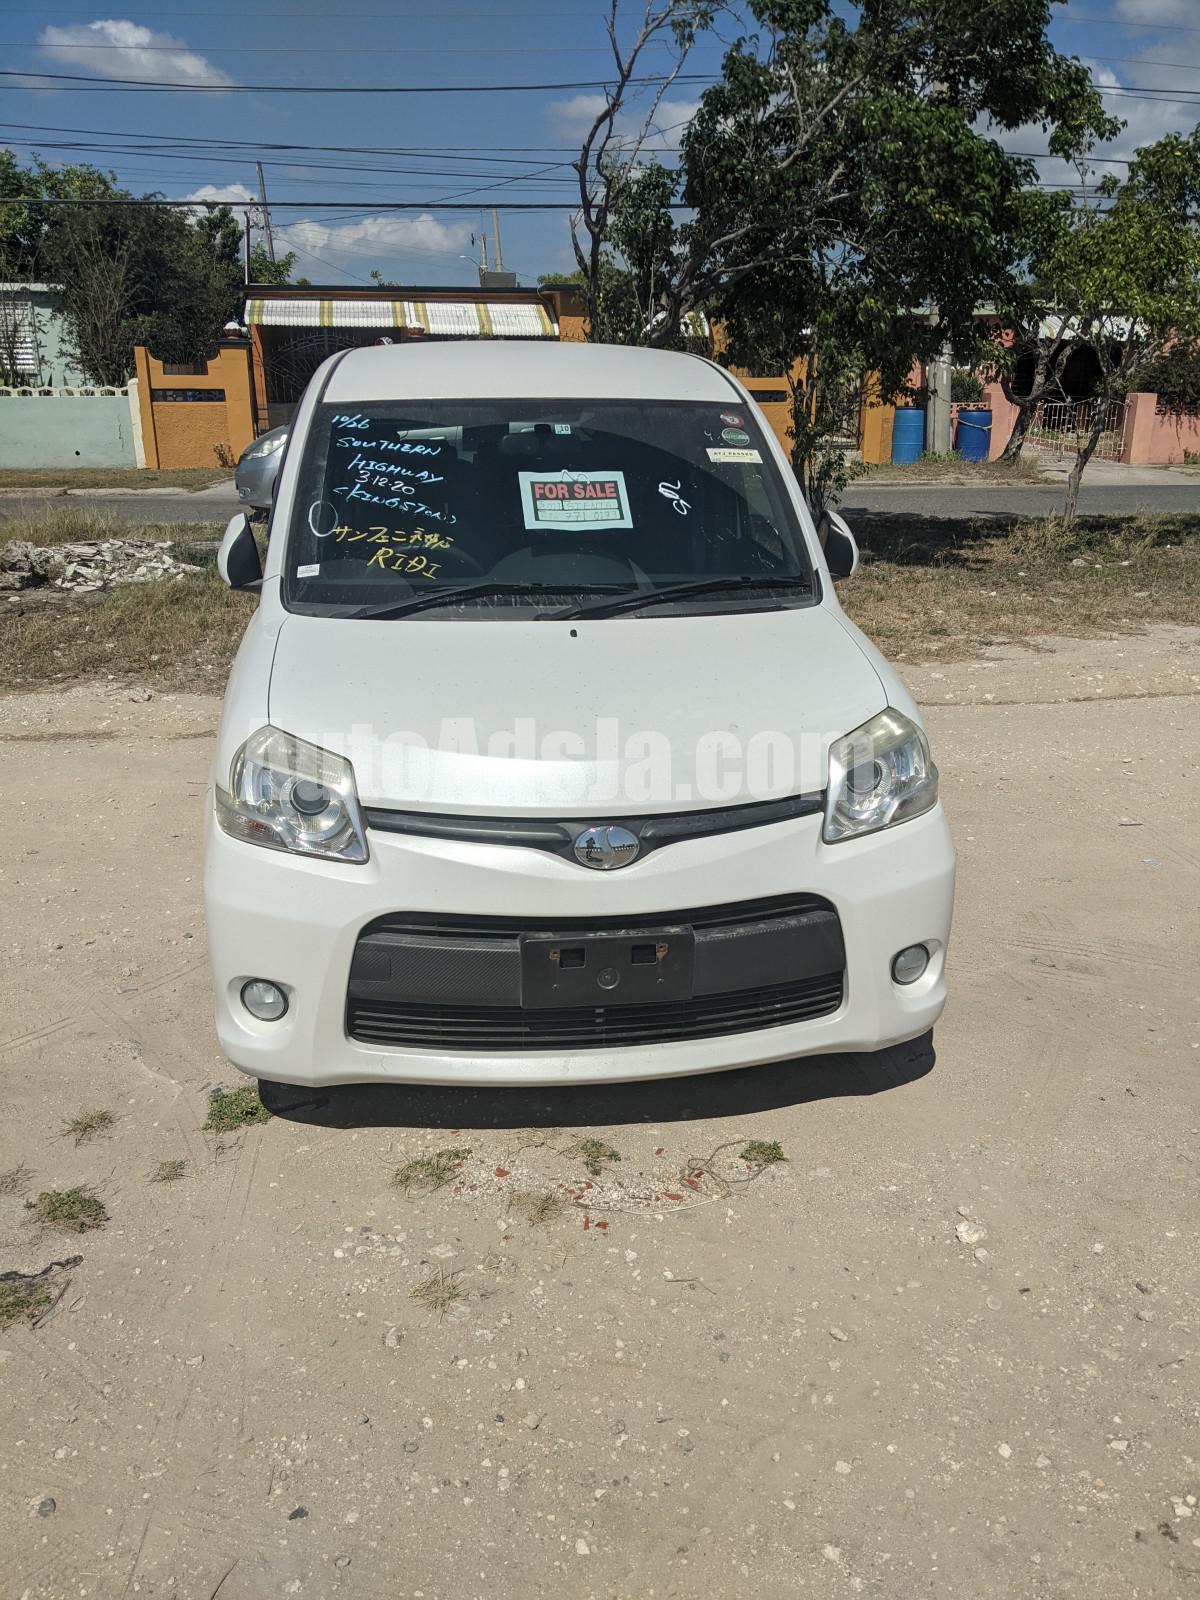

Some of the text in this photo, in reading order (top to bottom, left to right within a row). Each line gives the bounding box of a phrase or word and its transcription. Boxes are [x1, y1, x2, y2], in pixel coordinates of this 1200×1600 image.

[336, 437, 441, 456] SOUTHERN
[347, 453, 444, 484] HIGHWAY
[534, 483, 617, 499] FOR SALE
